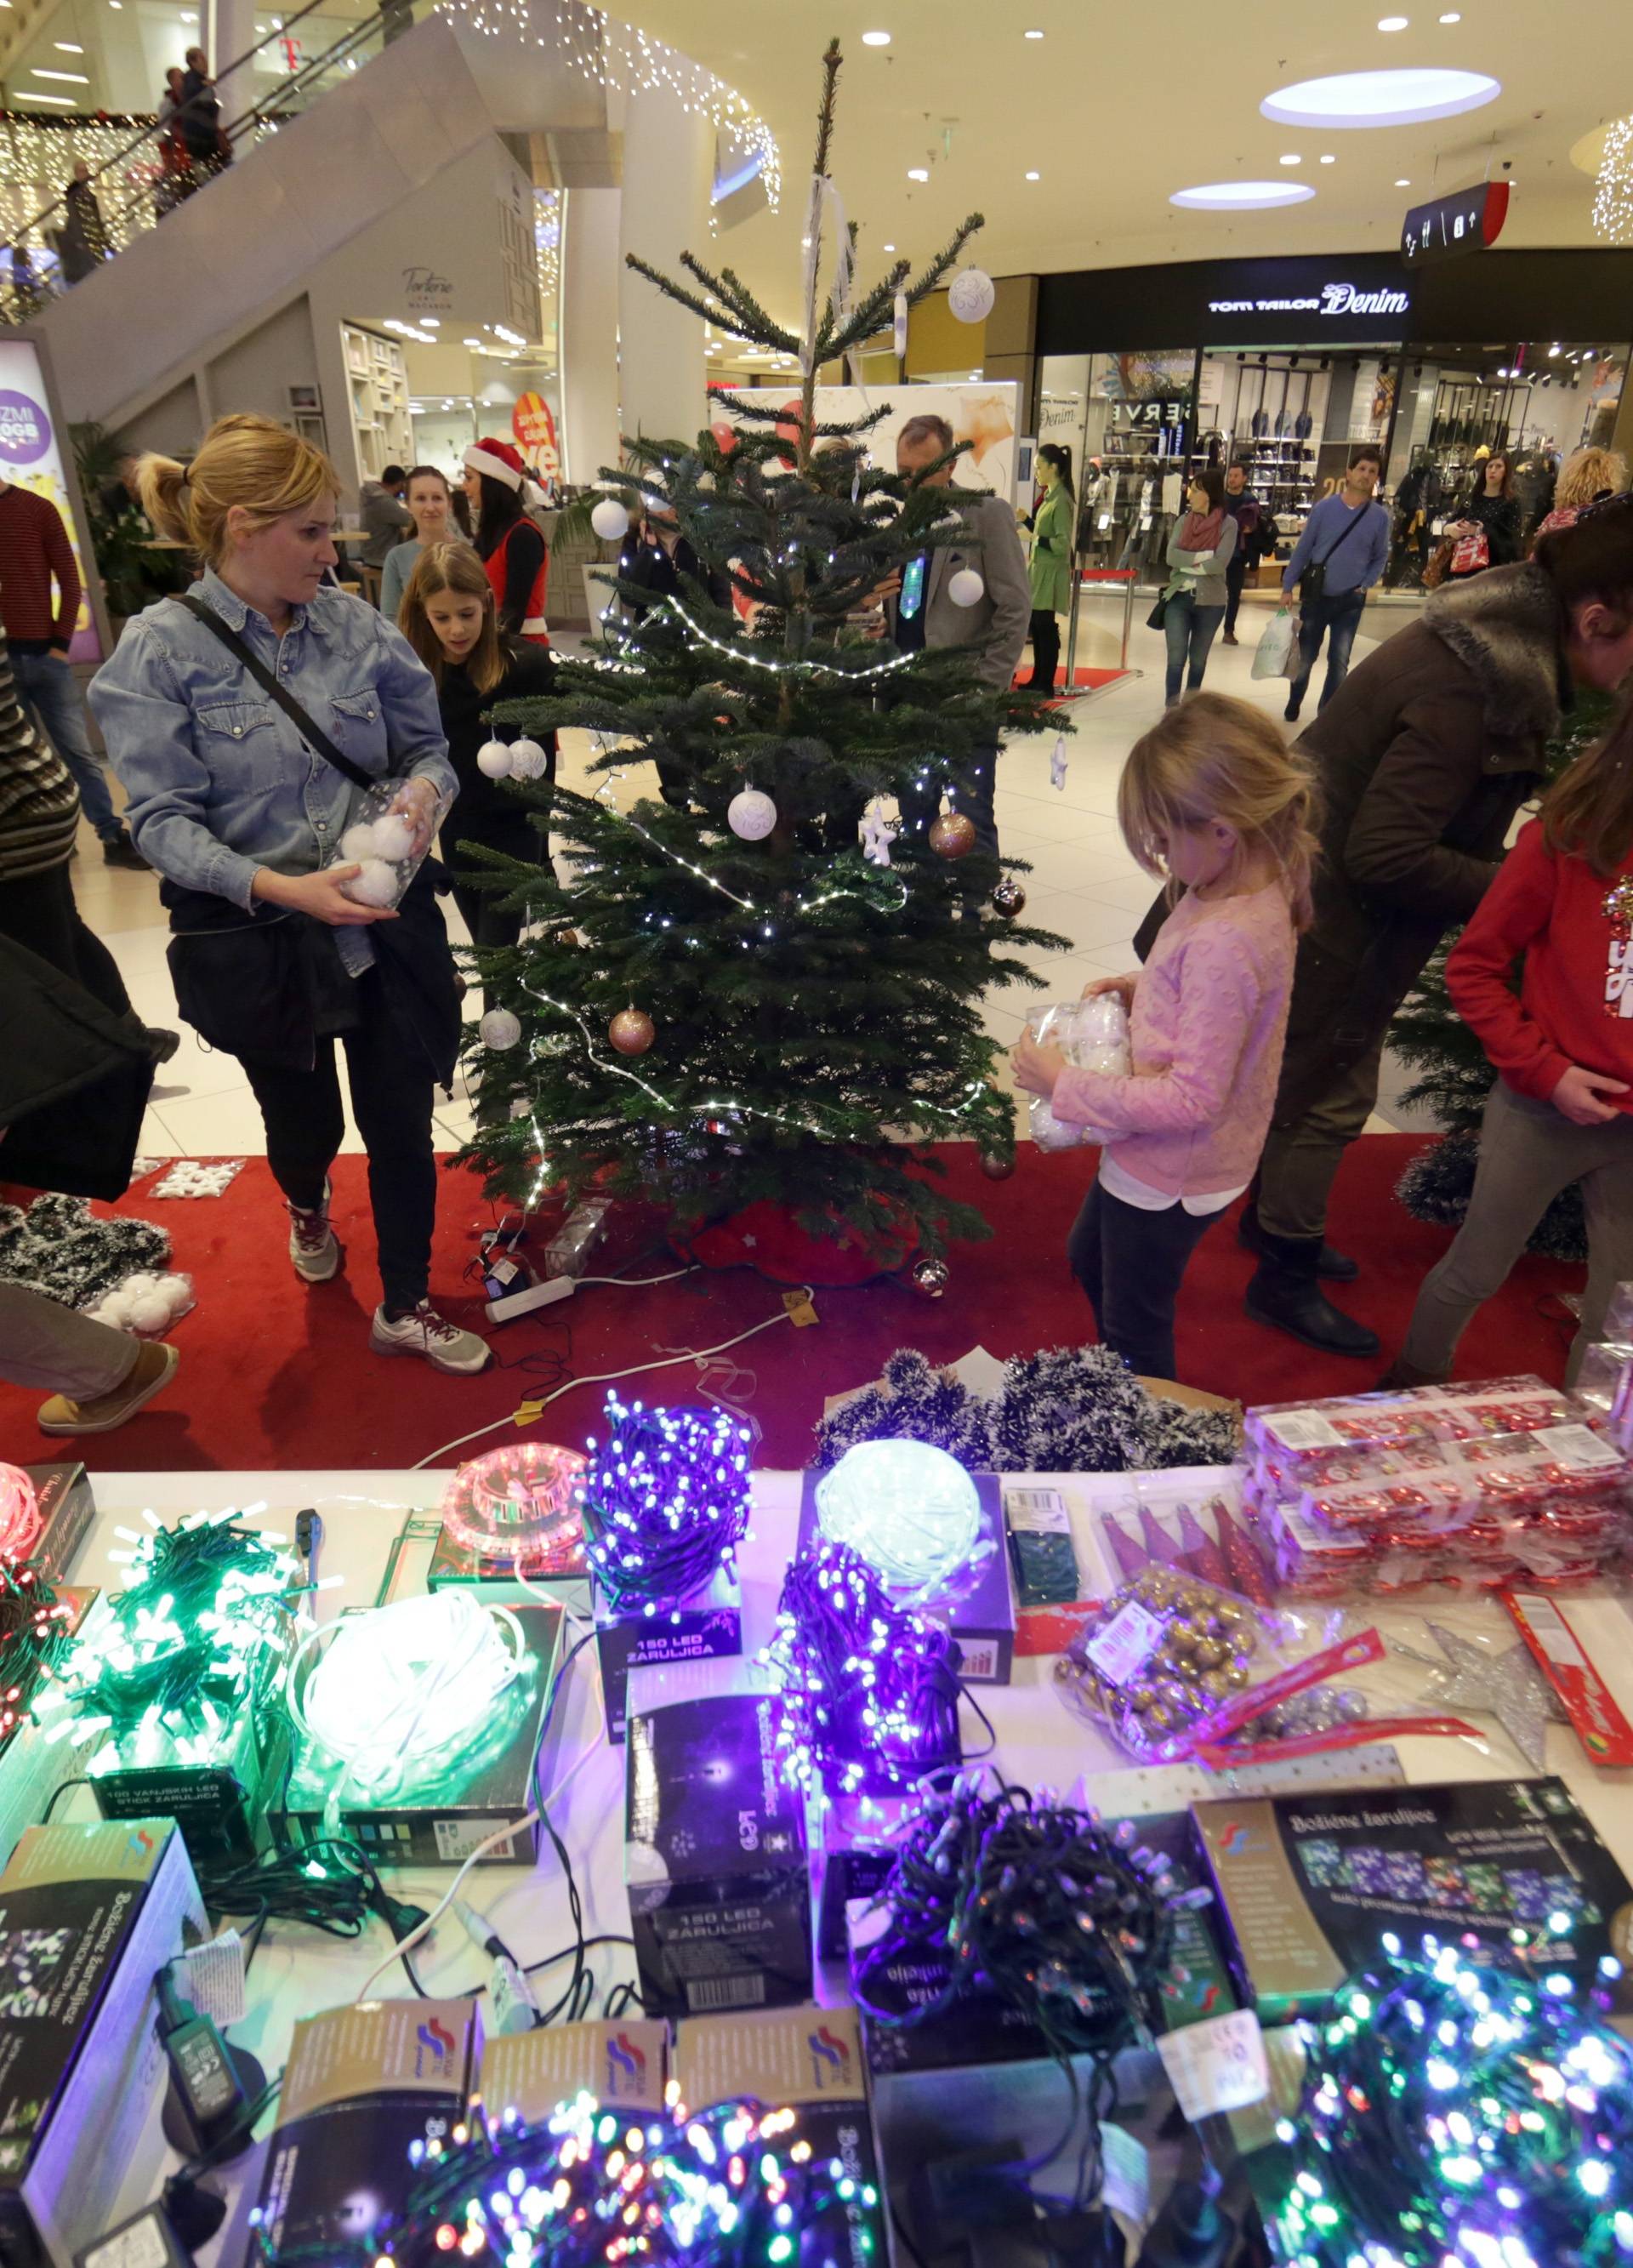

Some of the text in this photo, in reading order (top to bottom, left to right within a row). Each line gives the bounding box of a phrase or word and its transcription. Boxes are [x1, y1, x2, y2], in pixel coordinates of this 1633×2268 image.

[1209, 282, 1408, 315] TOM TAILOR Denim
[0, 406, 35, 422] ZMI
[636, 1633, 703, 1650] 150 LED
[196, 1784, 219, 1792] LED
[738, 1809, 759, 1851] LED
[680, 1907, 761, 1926] 150 LED
